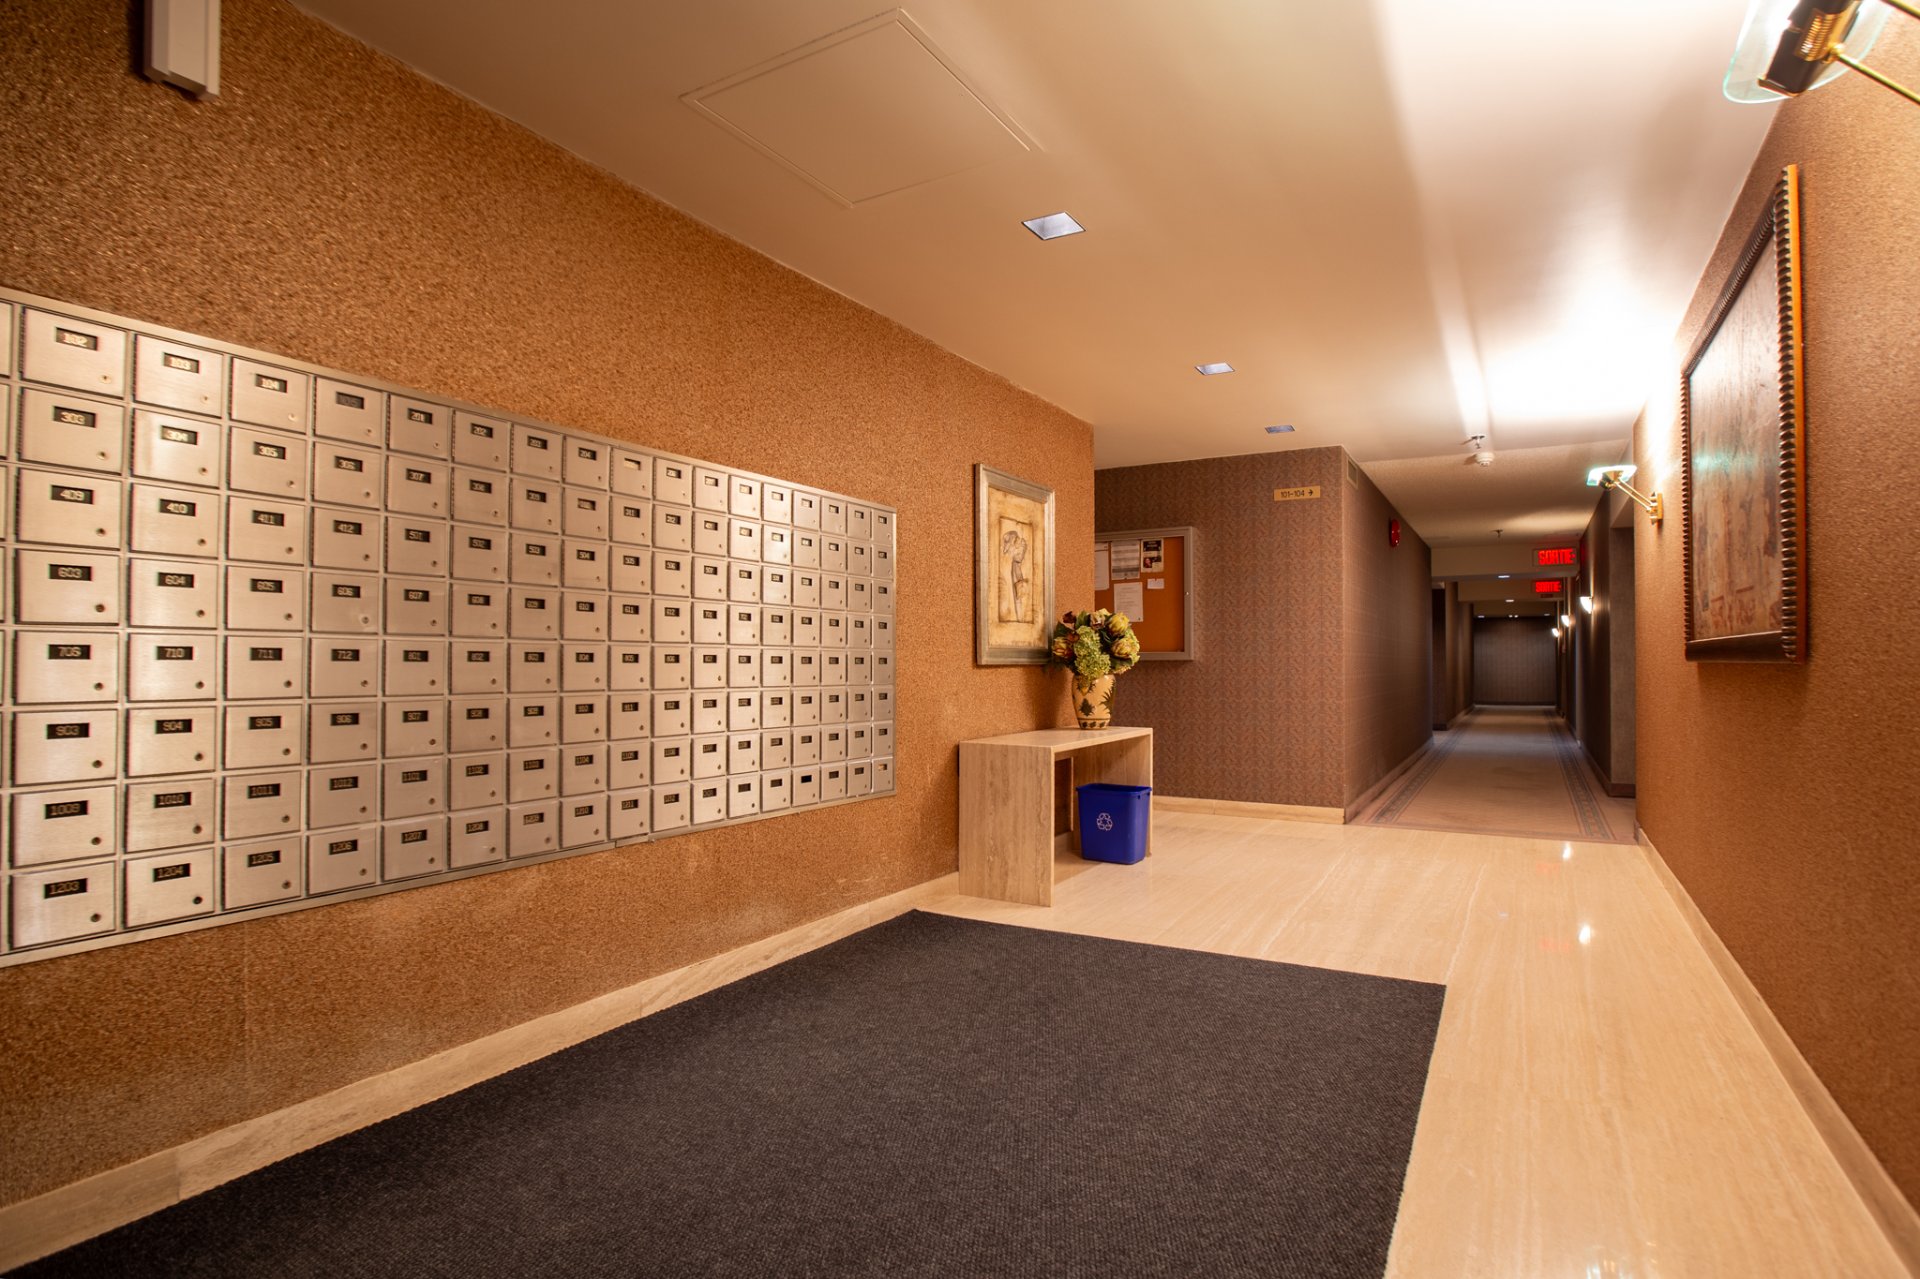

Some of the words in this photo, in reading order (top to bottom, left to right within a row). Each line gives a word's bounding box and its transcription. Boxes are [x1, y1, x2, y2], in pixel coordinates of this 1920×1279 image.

[63, 331, 88, 348] 102
[169, 356, 191, 371] 103
[261, 377, 280, 391] 104
[60, 410, 86, 426] 303
[410, 410, 425, 422] 201
[166, 429, 189, 443] 304
[473, 425, 487, 437] 202
[258, 445, 279, 458] 305
[580, 449, 591, 459] 204
[338, 459, 356, 471] 306
[408, 470, 425, 482] 307
[60, 488, 85, 502] 409
[1280, 489, 1305, 499] 101-104
[166, 501, 188, 514] 410
[257, 513, 275, 525] 411
[337, 523, 355, 534] 412
[408, 530, 423, 541] 501
[472, 538, 485, 548] 502
[579, 551, 591, 560] 504
[1537, 548, 1573, 566] SORTIE
[57, 566, 83, 579] 603
[164, 574, 186, 586] 604
[256, 581, 275, 592] 605
[337, 586, 354, 597] 606
[1535, 581, 1561, 593] SORTIE
[408, 590, 423, 600] 607
[578, 602, 590, 611] 610
[164, 648, 185, 658] 710
[257, 649, 275, 659] 711
[337, 650, 353, 660] 712
[407, 651, 422, 661] 801
[471, 652, 484, 661] 802
[575, 755, 590, 765] 1104
[467, 765, 484, 775] 1102
[402, 771, 420, 782] 1101
[333, 778, 354, 789] 1012
[251, 785, 274, 797] 1011
[158, 793, 185, 806] 1010
[404, 831, 423, 842] 1207
[332, 841, 352, 853] 1206
[251, 852, 274, 865] 1205
[157, 865, 184, 879] 1204
[49, 880, 80, 895] 1203
